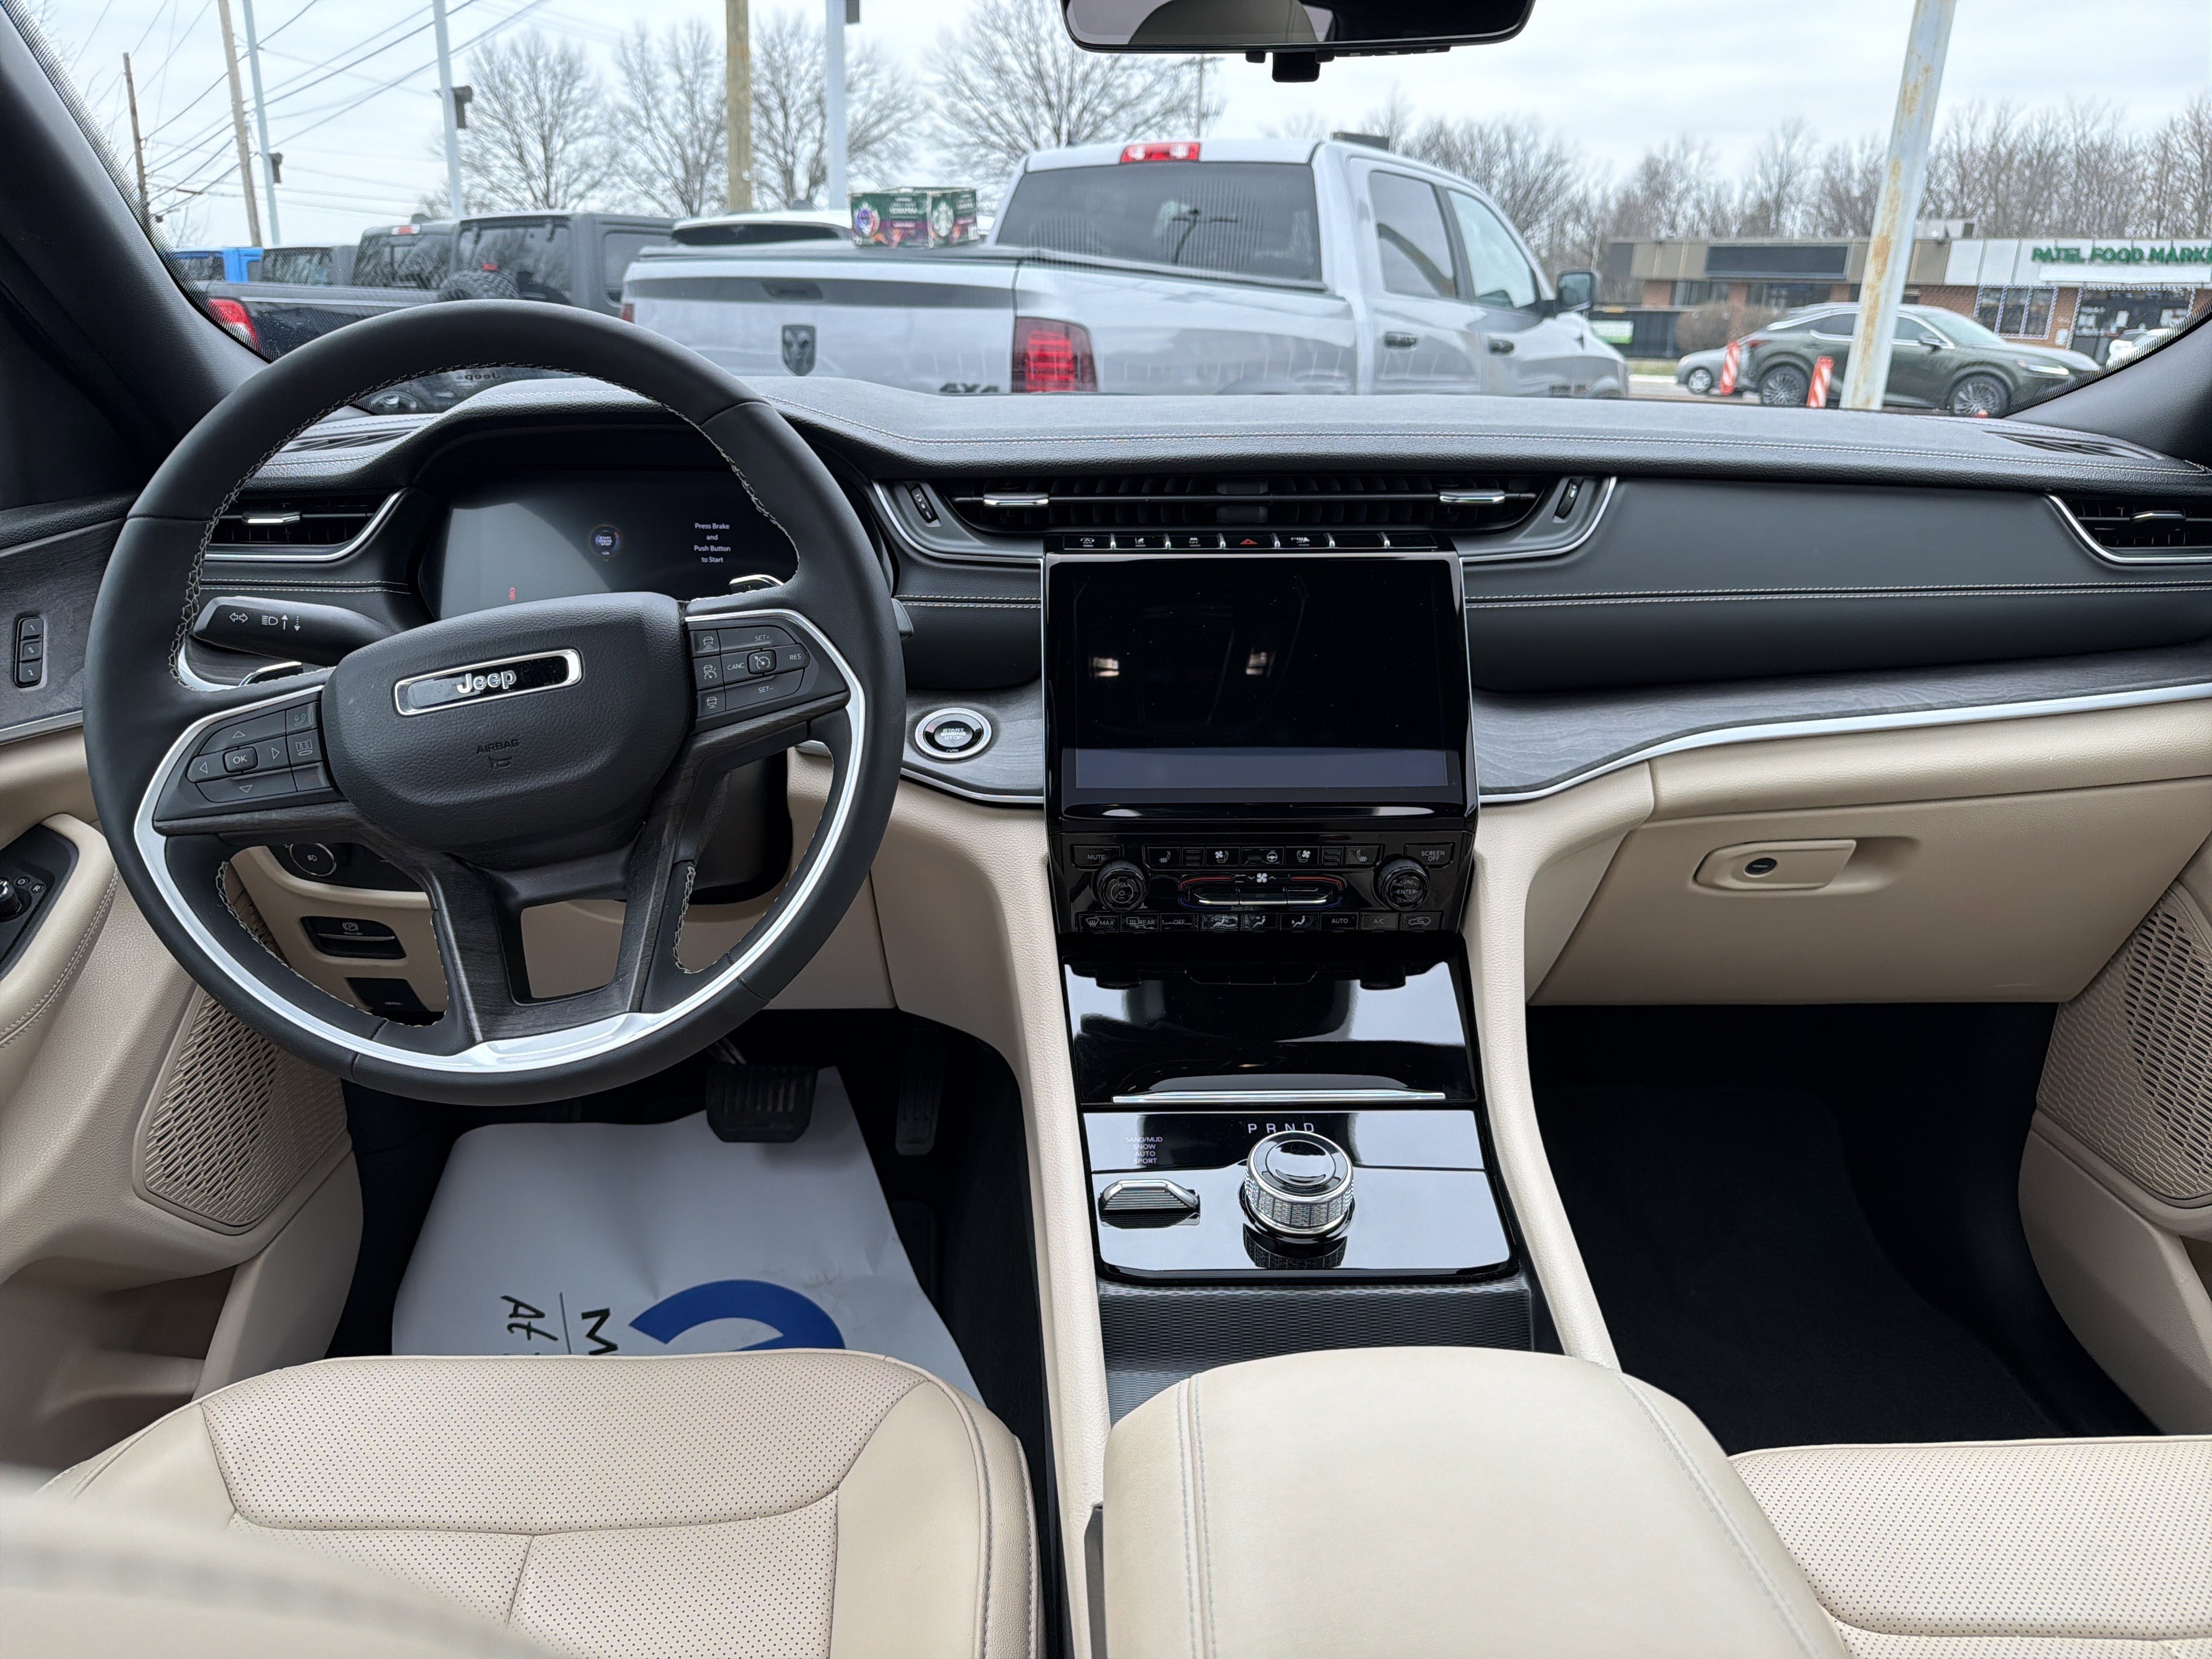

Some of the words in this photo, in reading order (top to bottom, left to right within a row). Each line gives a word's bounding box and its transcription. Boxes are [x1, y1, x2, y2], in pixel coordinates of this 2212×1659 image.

[2089, 247, 2144, 264] FOOD
[456, 669, 517, 695] Jeep
[476, 738, 520, 754] AIRBAG
[233, 754, 248, 764] OK
[1248, 1122, 1257, 1134] P
[1266, 1122, 1277, 1134] R
[1284, 1122, 1295, 1131] N
[1303, 1122, 1314, 1133] D
[580, 1307, 618, 1355] M
